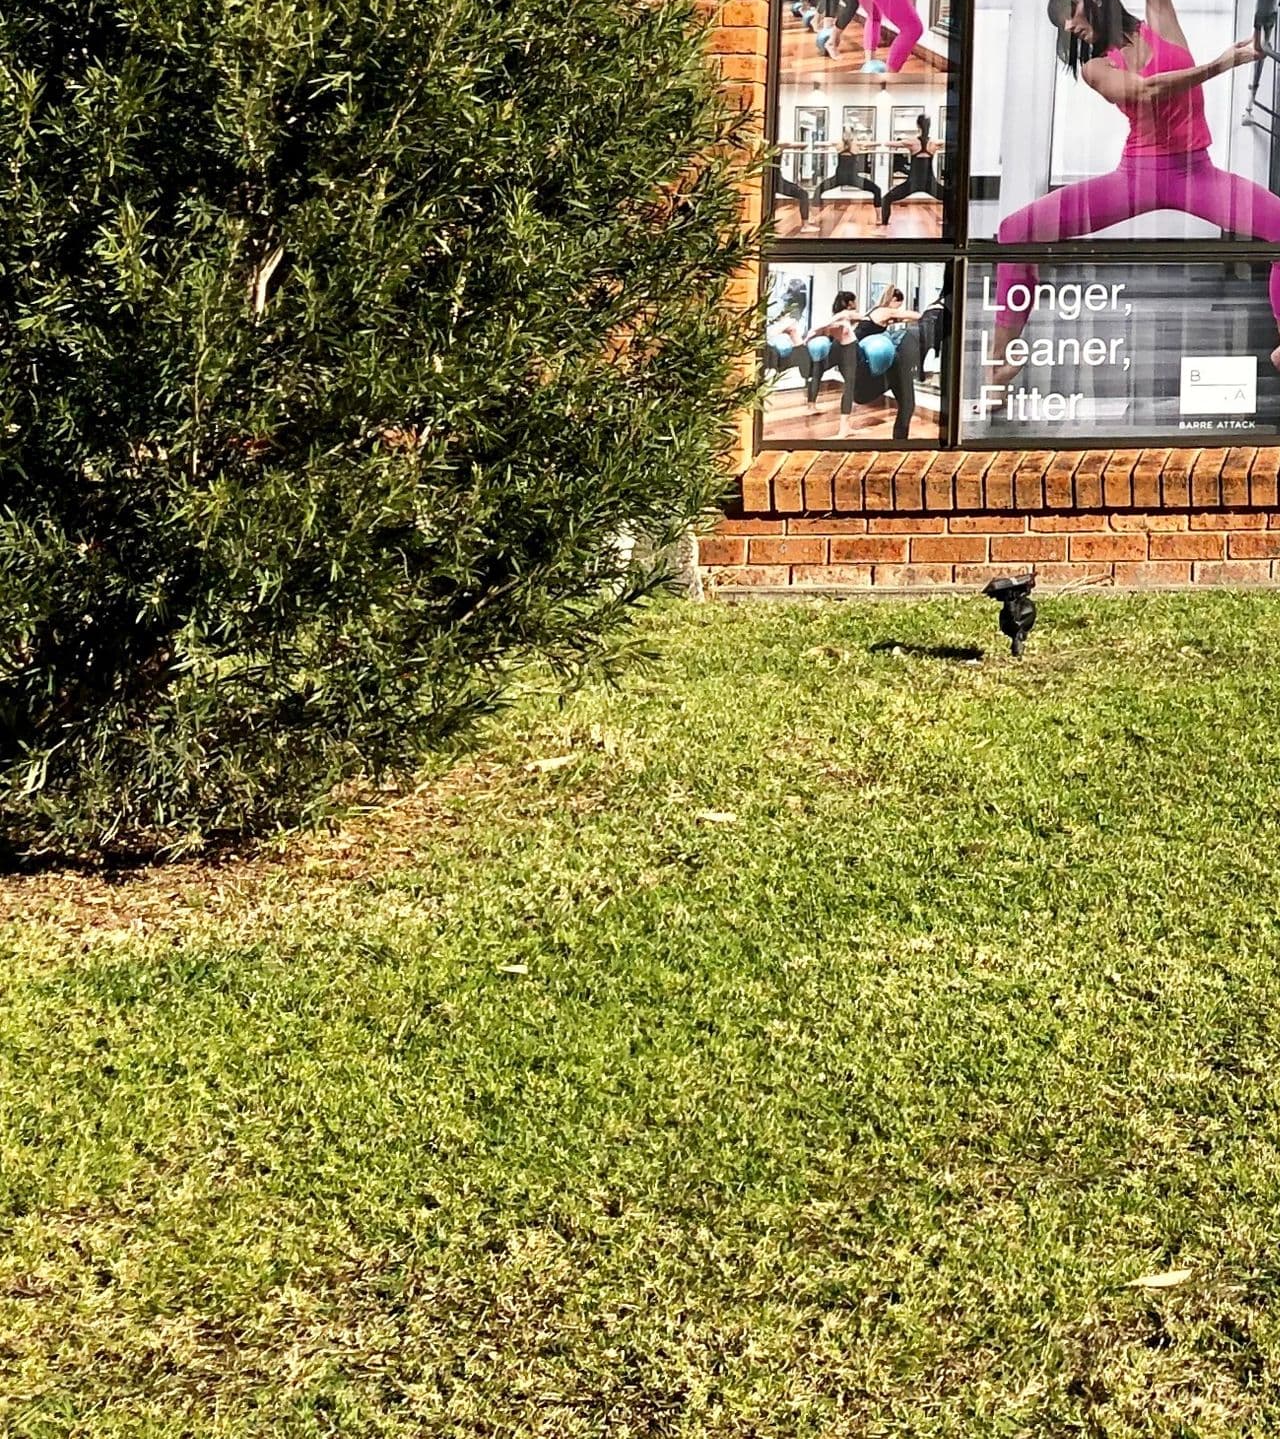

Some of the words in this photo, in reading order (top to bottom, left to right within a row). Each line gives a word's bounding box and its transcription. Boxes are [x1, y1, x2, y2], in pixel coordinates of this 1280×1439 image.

[982, 275, 1133, 320] Longer,
[980, 329, 1132, 371] Leaner,
[1179, 420, 1213, 429] BARRE
[1216, 420, 1256, 429] ATTACK
